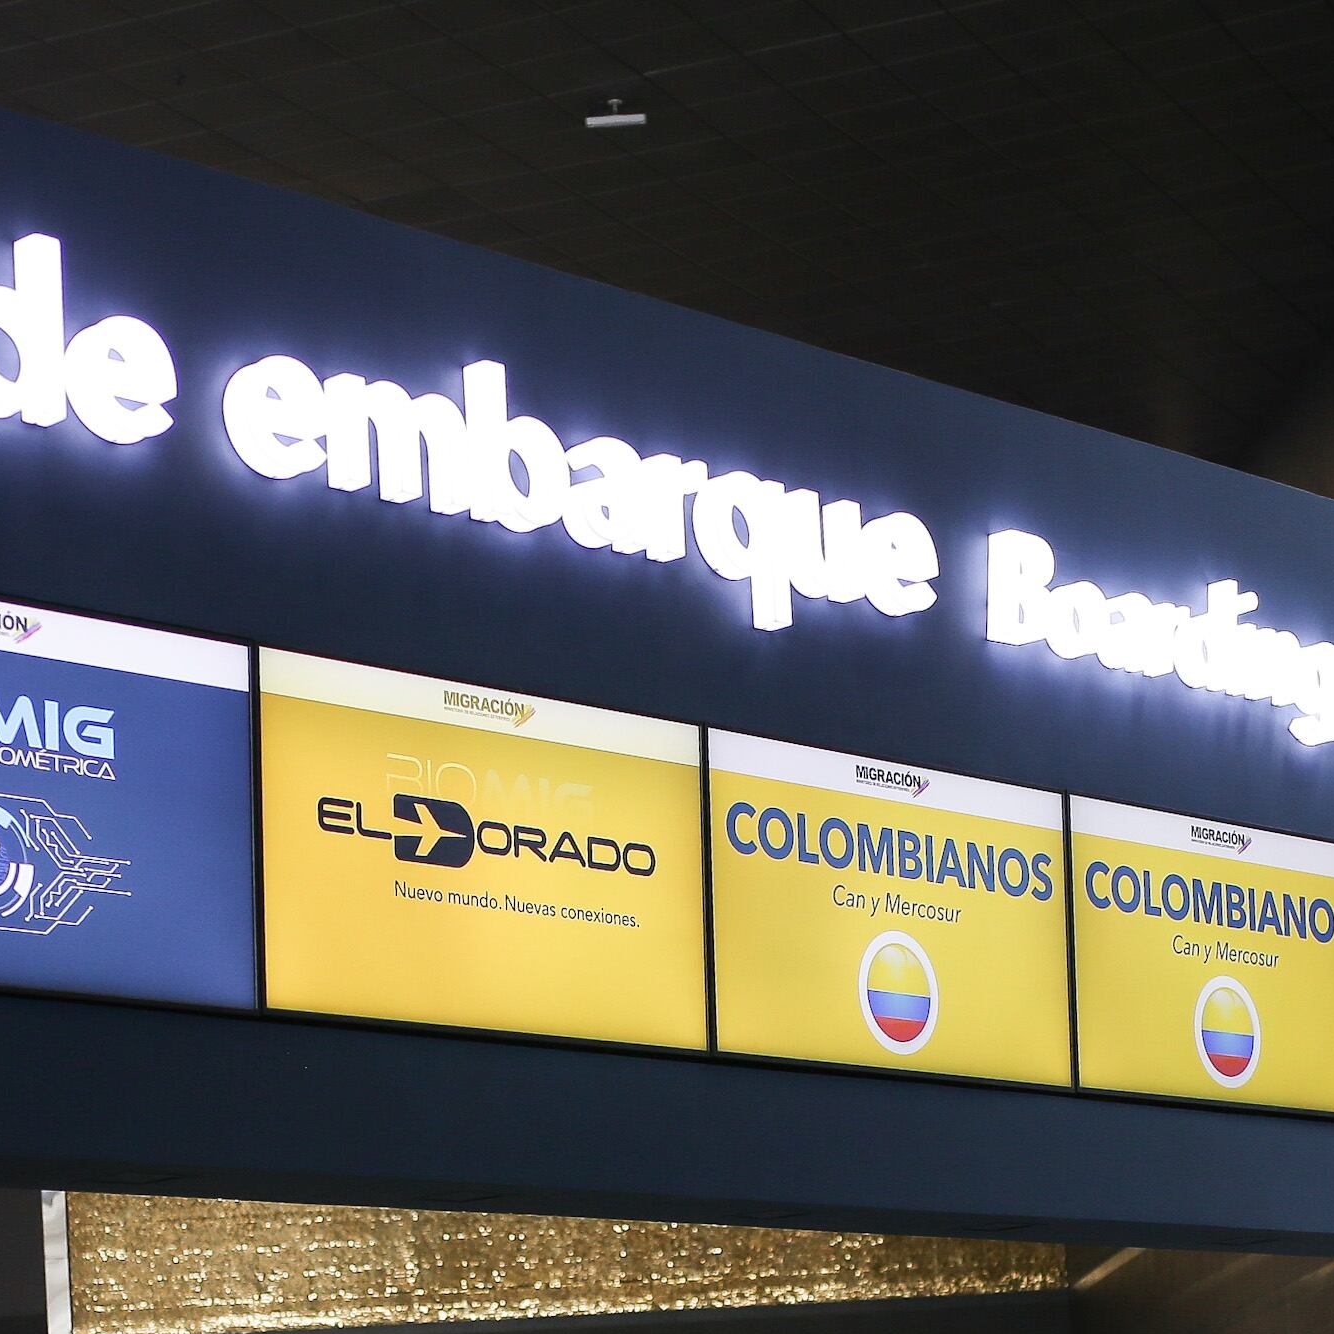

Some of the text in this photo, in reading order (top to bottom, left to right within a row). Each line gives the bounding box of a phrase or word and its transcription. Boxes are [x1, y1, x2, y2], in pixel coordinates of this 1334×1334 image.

[223, 354, 940, 632] embarque
[444, 690, 524, 717] MIGRACIÓN
[856, 765, 921, 788] MIGRACIÓN
[318, 796, 392, 840] EL
[1191, 825, 1245, 846] MIGRACIÓN
[725, 802, 1053, 902] COLOMBIANOS
[394, 881, 640, 928] Nuevo mundo. Nuevas conexiones.
[832, 884, 962, 923] Can y Mercosur
[1172, 934, 1279, 968] Can y Mercosur
